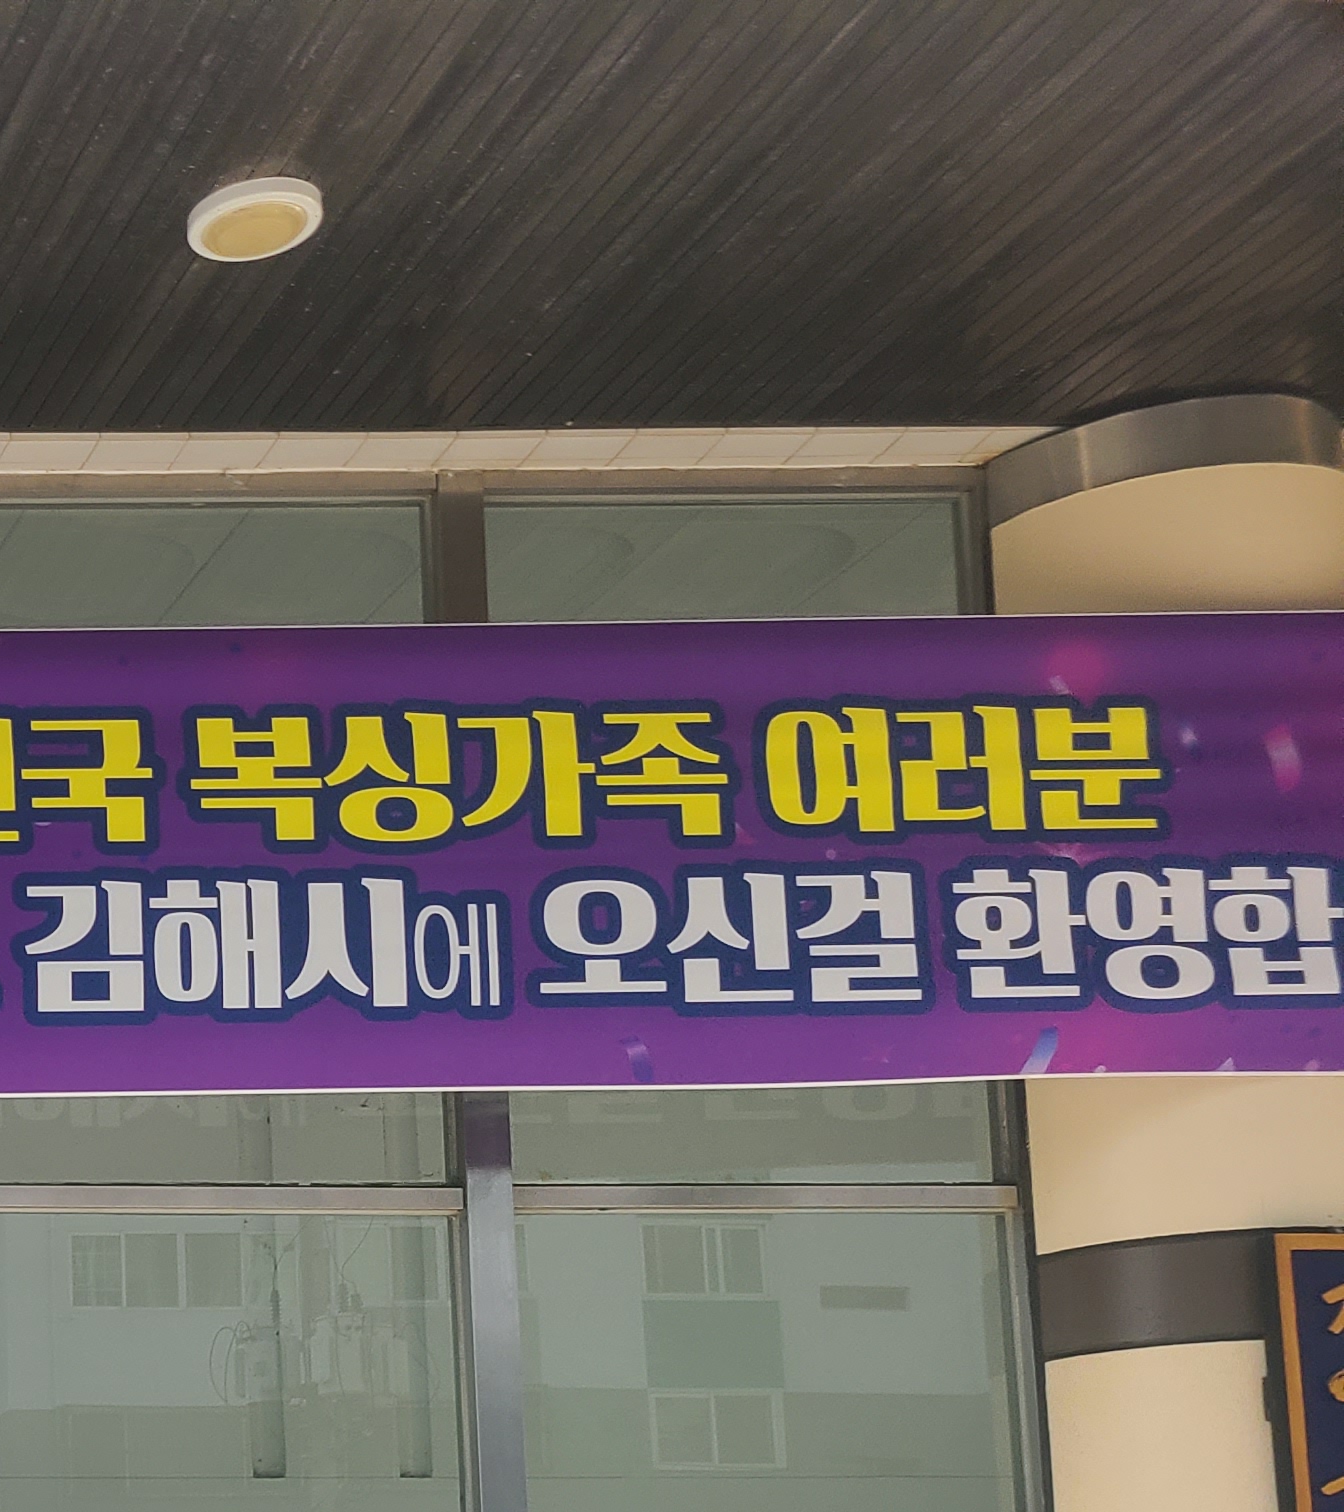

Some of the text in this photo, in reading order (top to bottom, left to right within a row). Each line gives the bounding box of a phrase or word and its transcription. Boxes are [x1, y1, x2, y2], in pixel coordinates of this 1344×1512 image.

[188, 709, 728, 844] 복싱가족
[765, 705, 1162, 832] 여러분
[23, 875, 500, 1013] 김해시에
[539, 869, 923, 1005] 오신걸
[954, 865, 1344, 1000] 환영합
